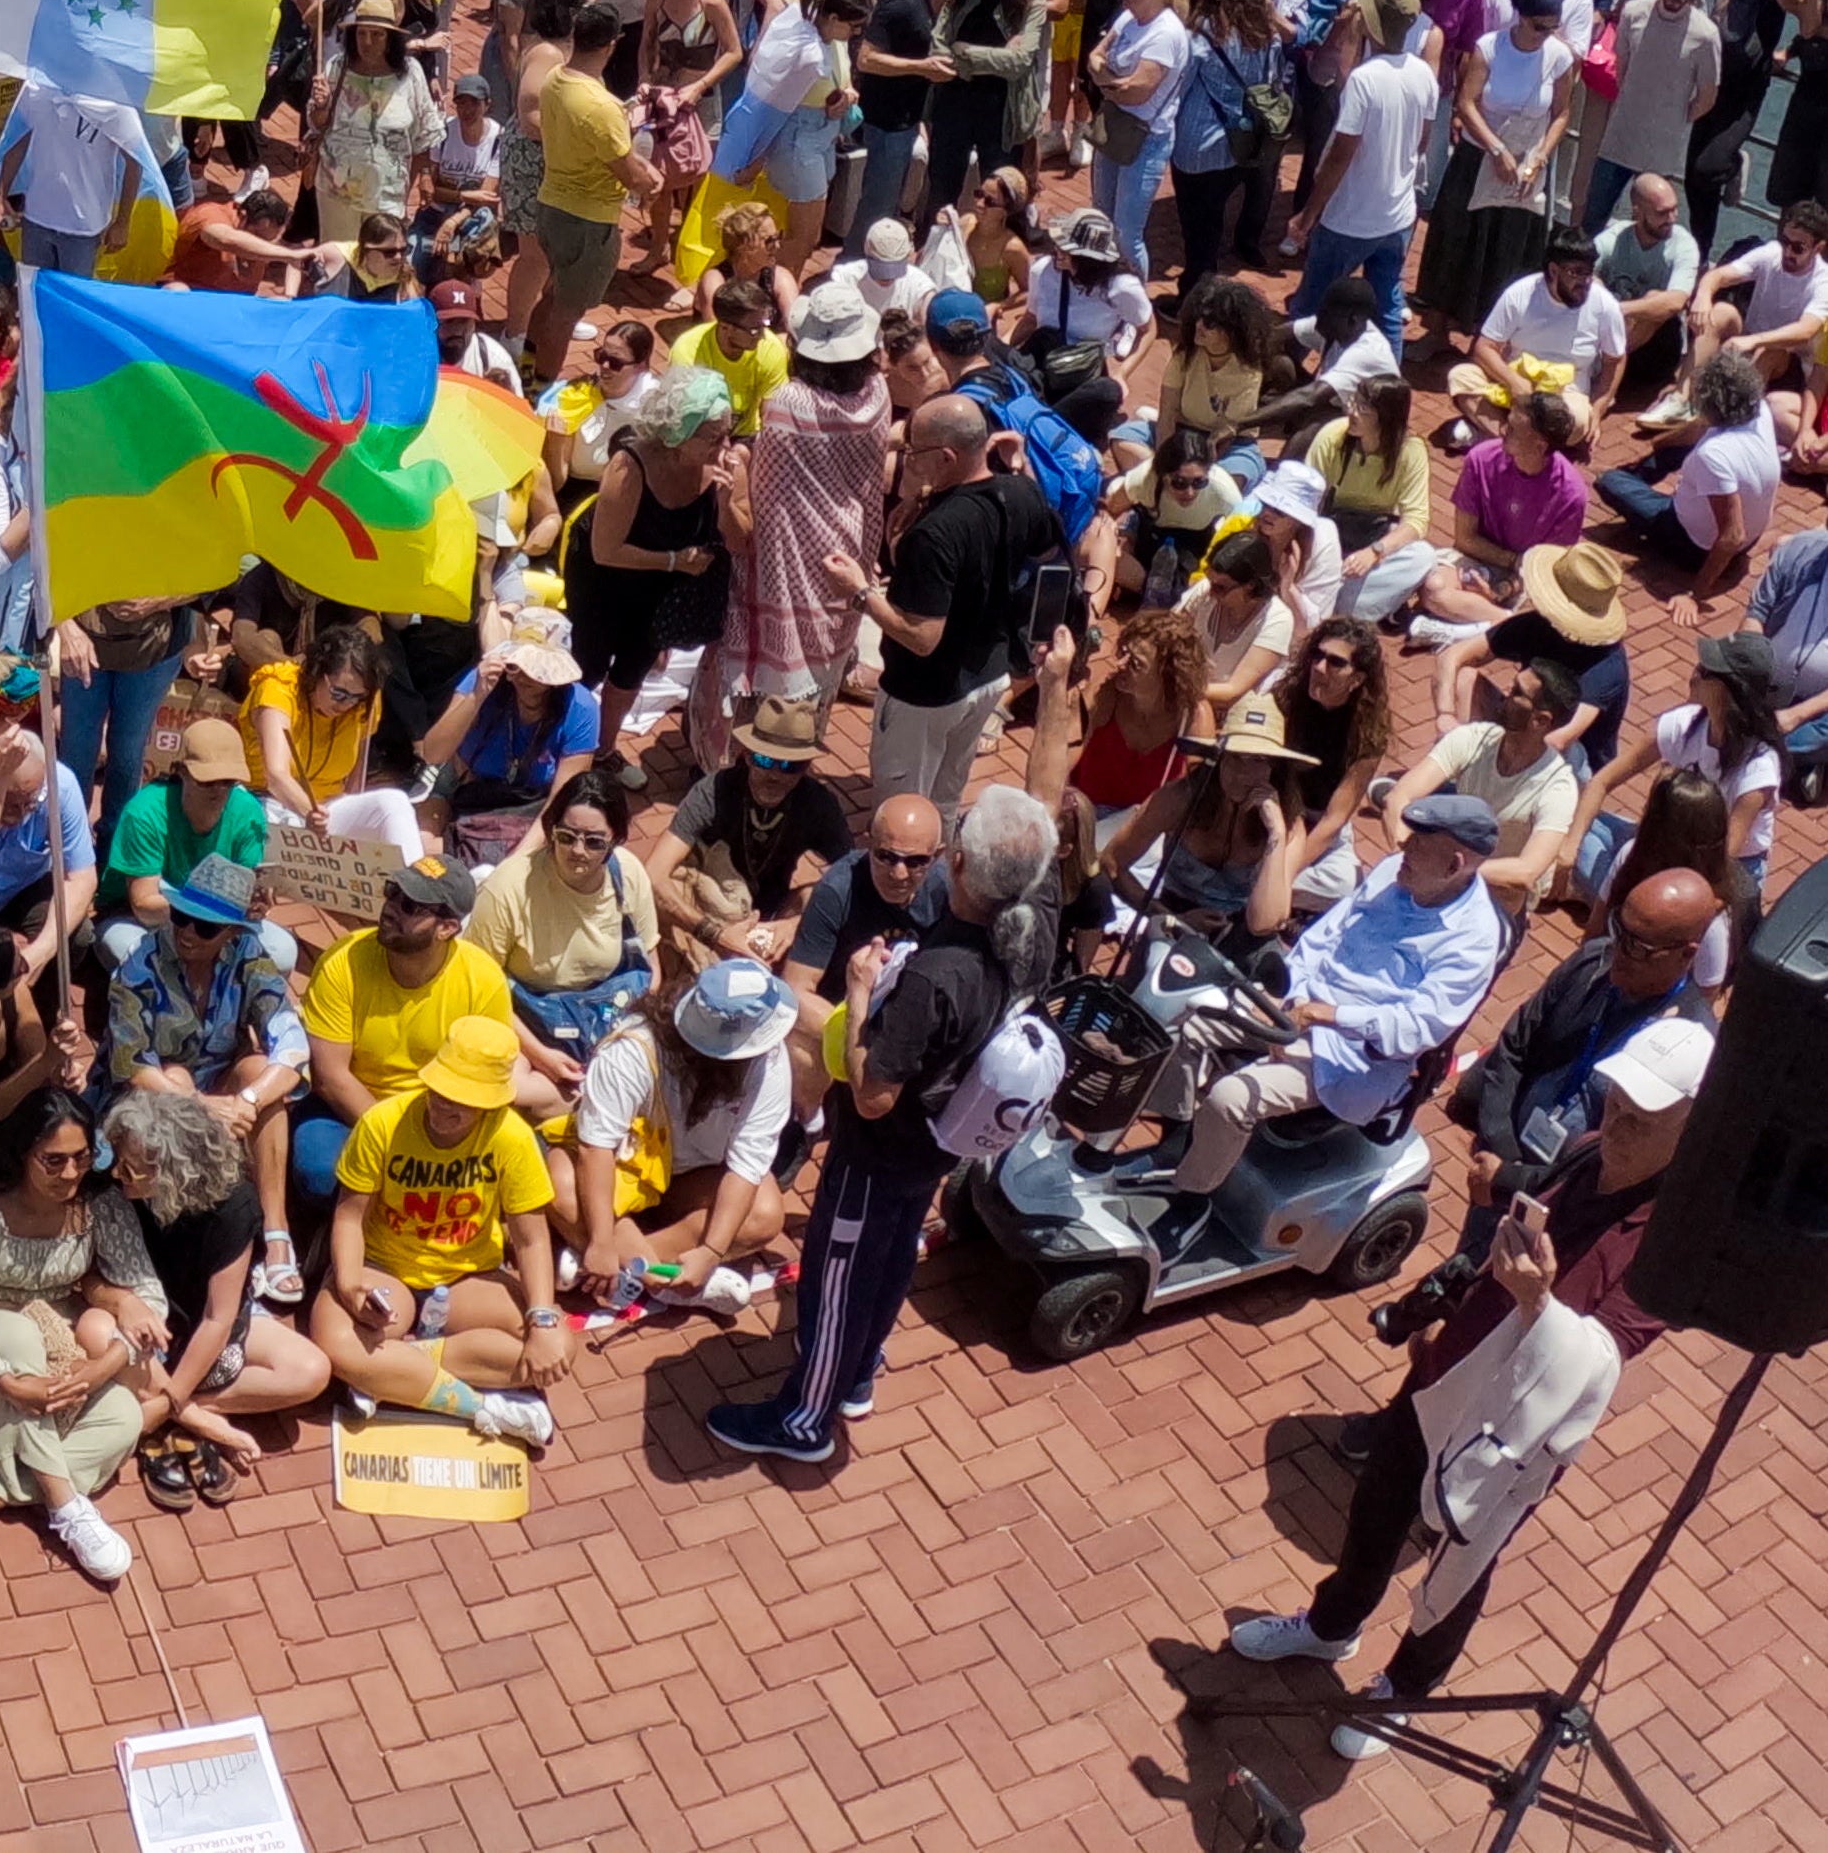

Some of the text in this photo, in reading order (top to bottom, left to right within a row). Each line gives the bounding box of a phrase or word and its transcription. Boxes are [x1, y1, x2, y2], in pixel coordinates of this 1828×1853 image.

[283, 830, 360, 857] NADA
[300, 884, 375, 913] DE LAS
[387, 1151, 497, 1189] CANARIAS
[402, 1190, 482, 1224] NO
[344, 1451, 523, 1490] CANARIAS TIENE UN LÍMITE
